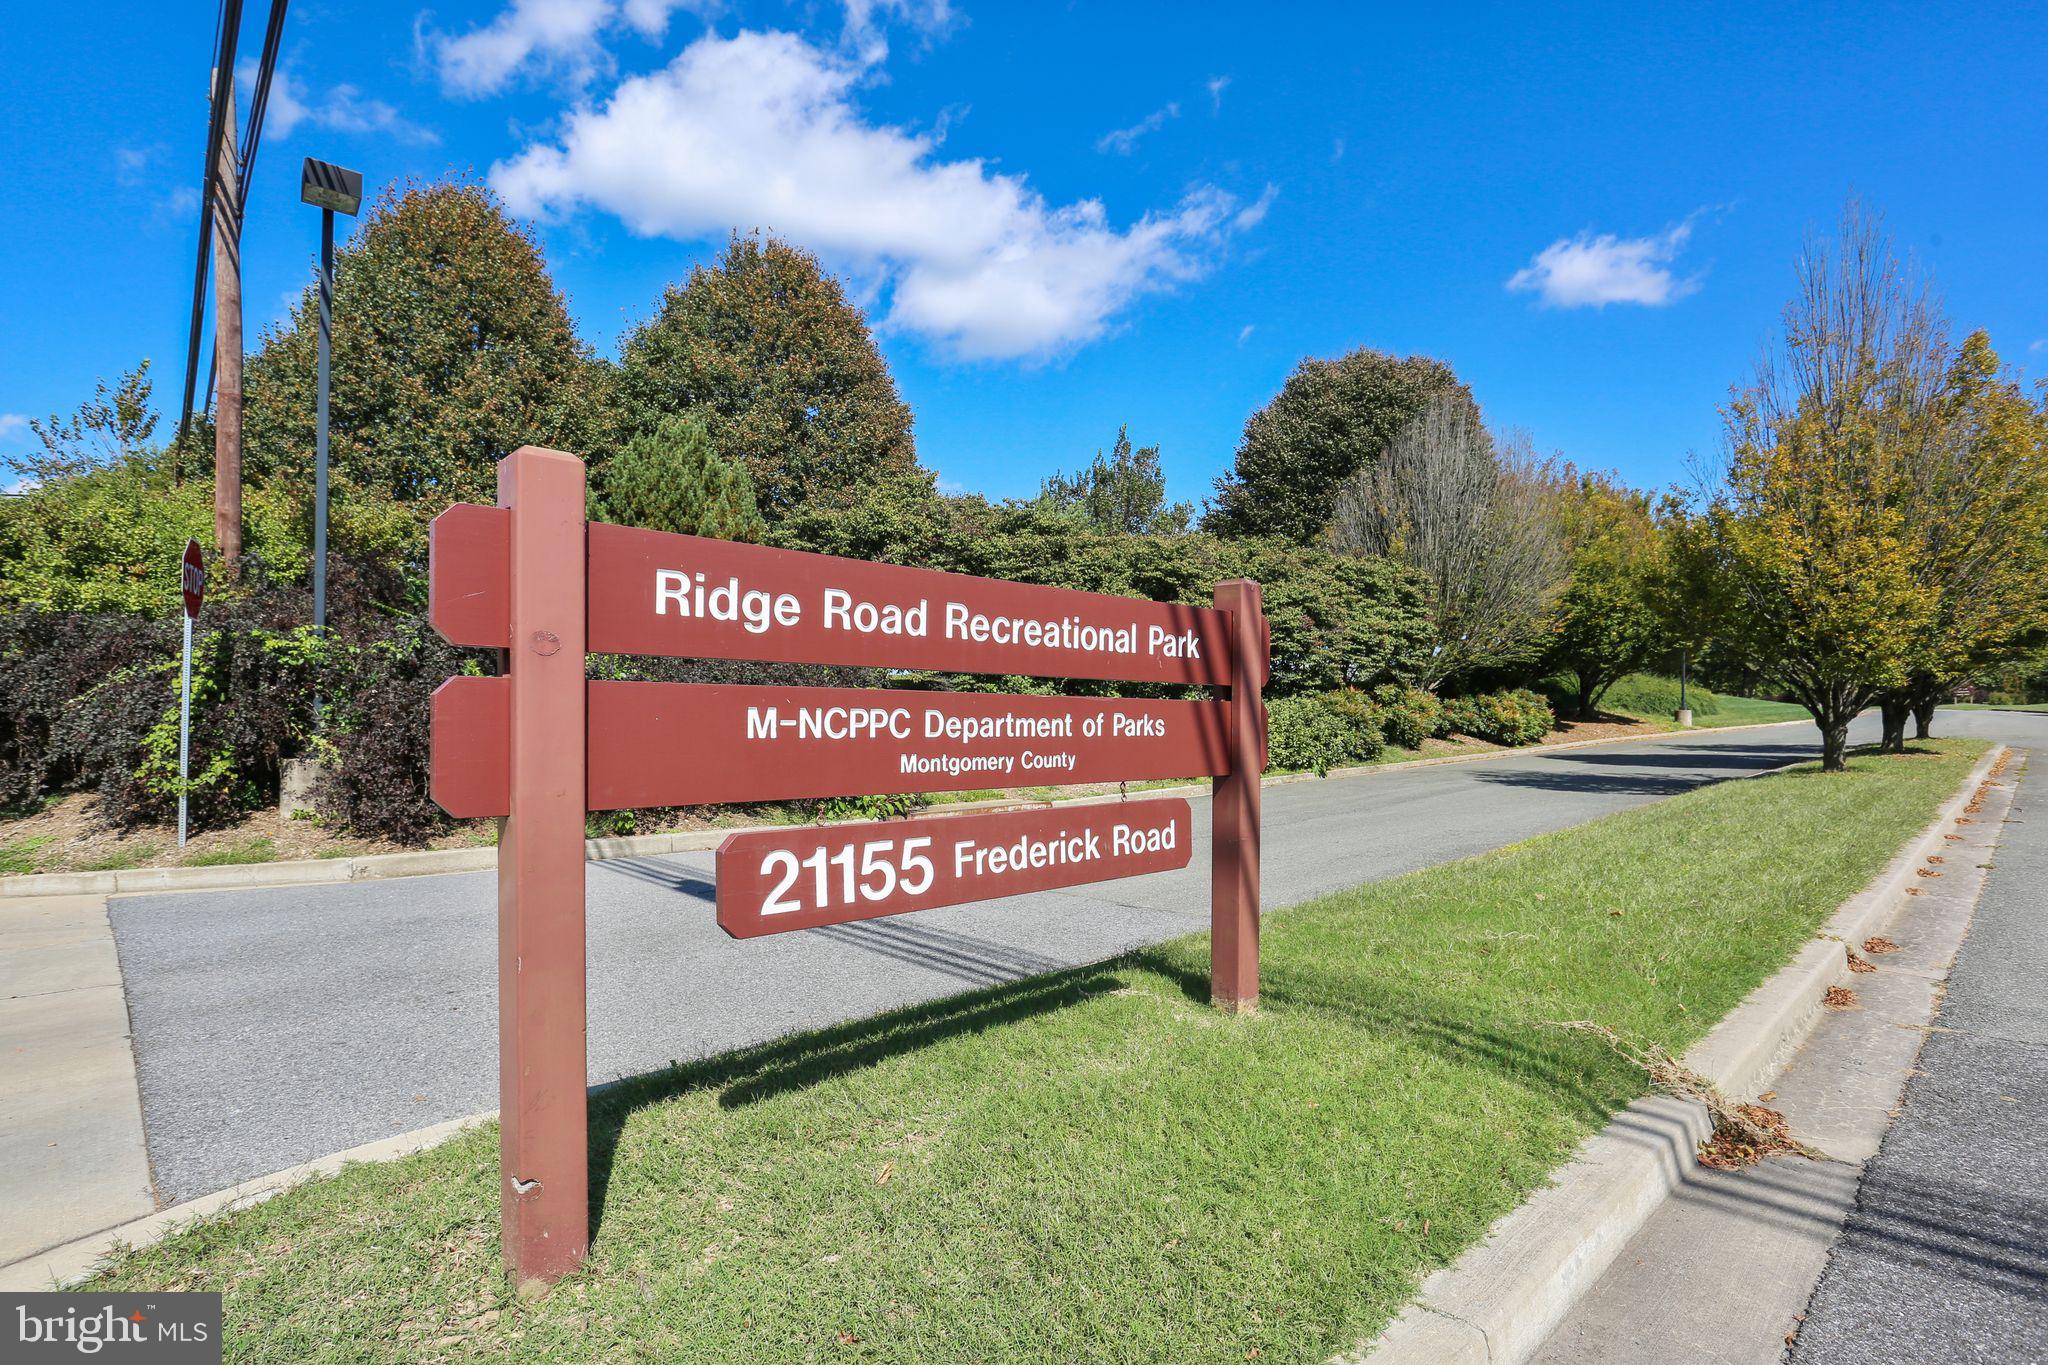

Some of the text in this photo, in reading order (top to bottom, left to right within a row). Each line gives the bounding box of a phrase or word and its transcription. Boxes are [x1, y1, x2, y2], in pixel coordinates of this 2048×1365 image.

[184, 562, 204, 597] STOP
[656, 569, 1199, 658] Ridge Road Recreational Park
[747, 707, 1165, 743] M-NCPPC Department of Parks
[901, 751, 1075, 776] Montgomery County
[760, 819, 1175, 916] 21155 Frederick Road
